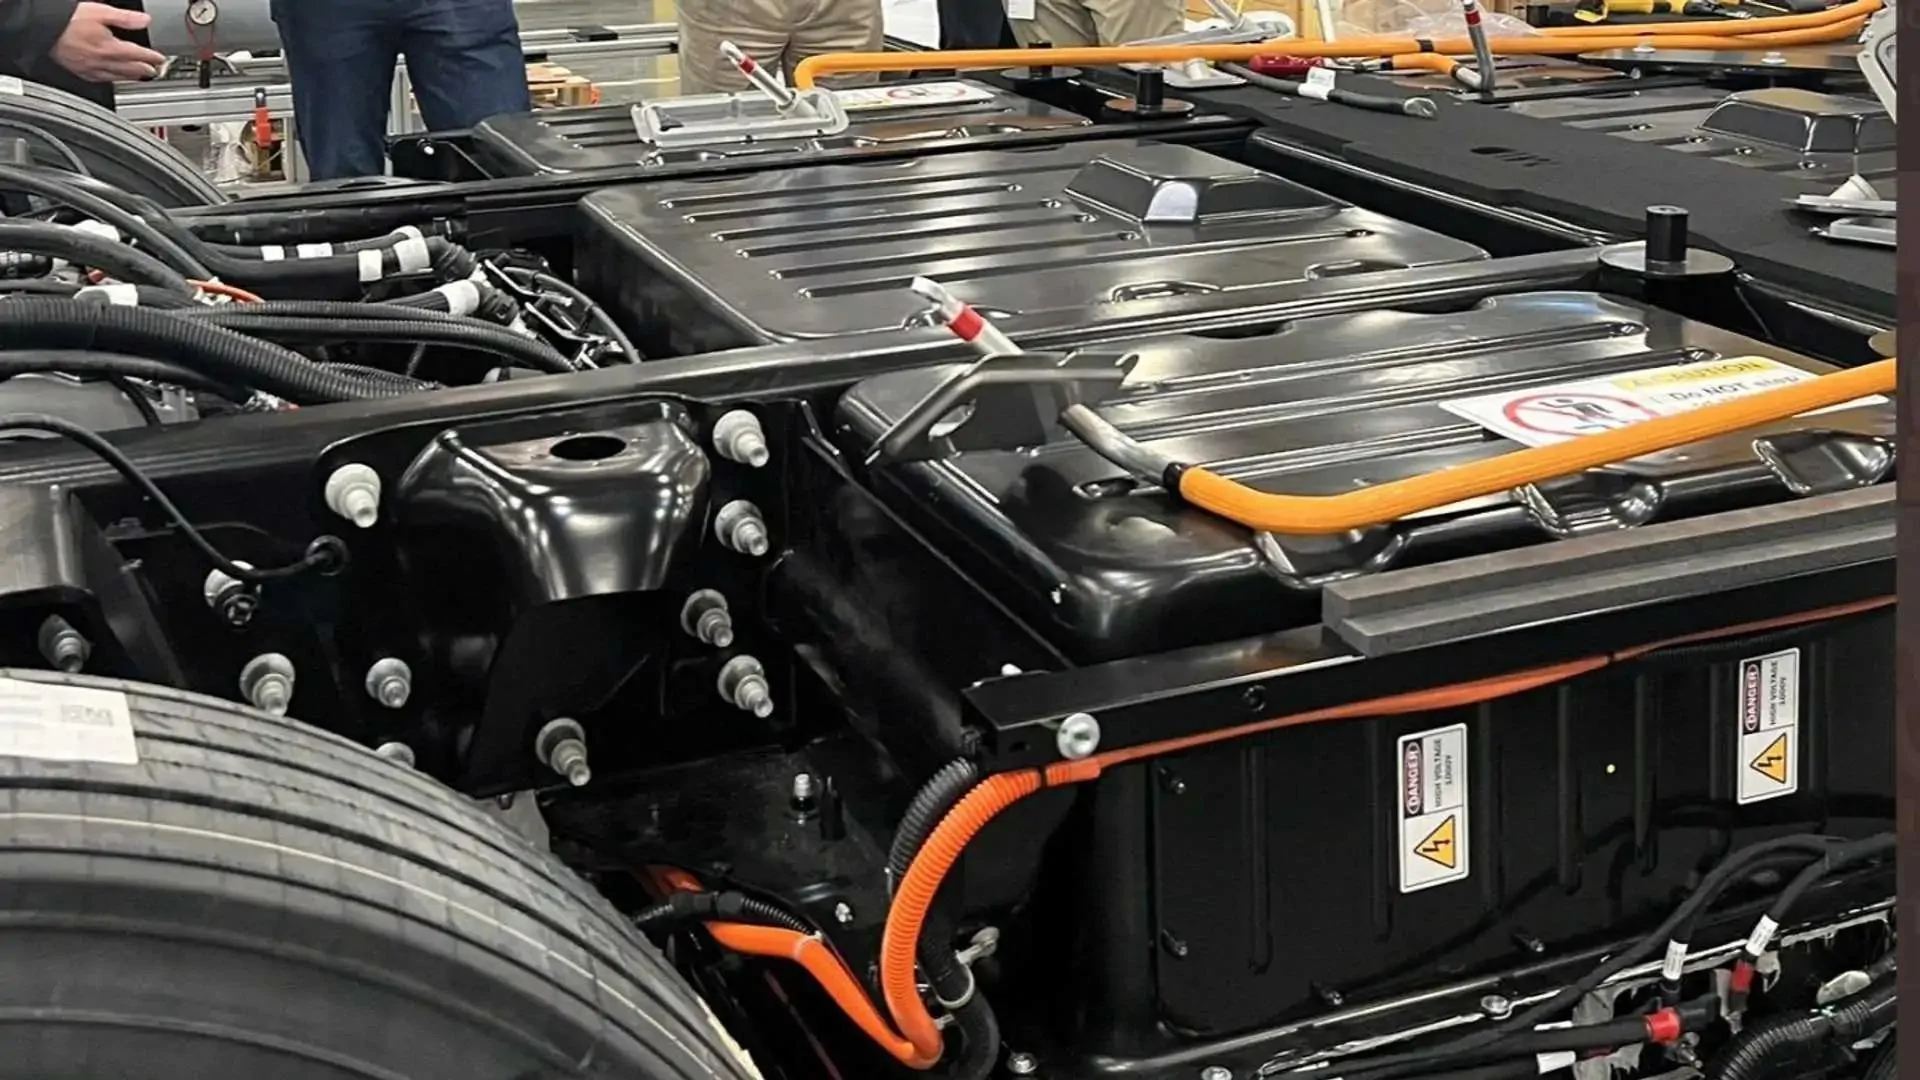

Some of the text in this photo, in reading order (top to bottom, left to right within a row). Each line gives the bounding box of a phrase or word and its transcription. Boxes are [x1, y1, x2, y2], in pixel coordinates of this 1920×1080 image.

[1655, 361, 1762, 382] CAUTION
[1701, 382, 1750, 397] NOT
[1747, 671, 1758, 725] DANGER
[1407, 750, 1420, 807] DANGER
[1434, 739, 1442, 808] HIGH VOLTAGE
